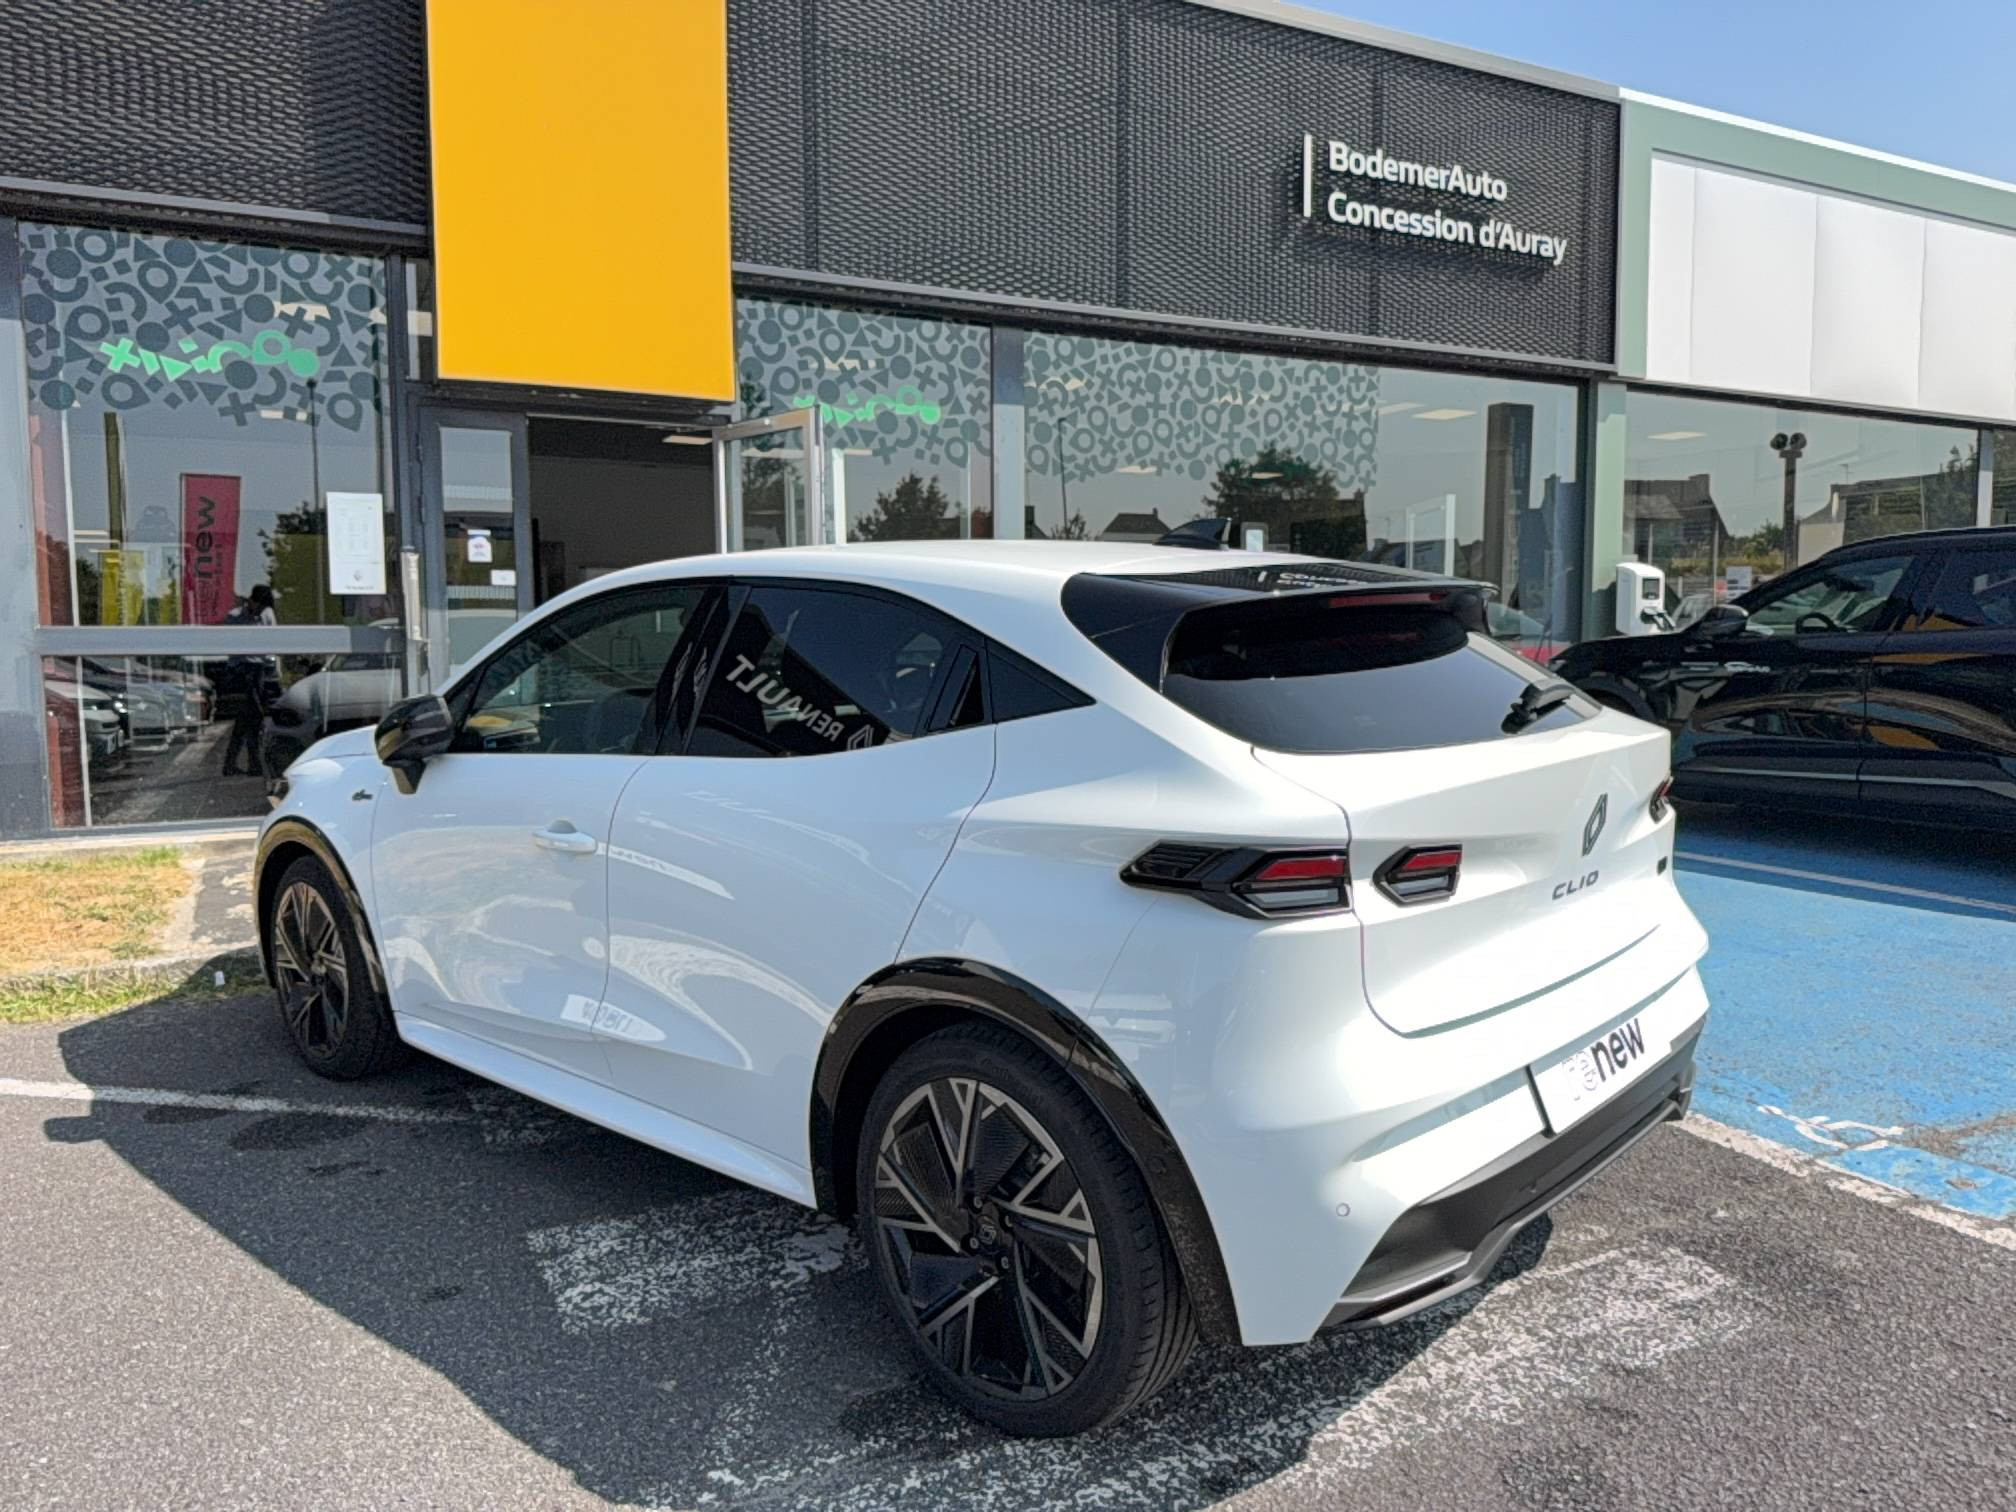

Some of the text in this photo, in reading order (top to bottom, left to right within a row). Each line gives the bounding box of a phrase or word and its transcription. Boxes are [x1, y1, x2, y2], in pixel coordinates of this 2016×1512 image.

[1328, 140, 1508, 202] BodemerAuto
[1327, 191, 1568, 265] Concession d'Auray
[1552, 870, 1599, 901] CLIO
